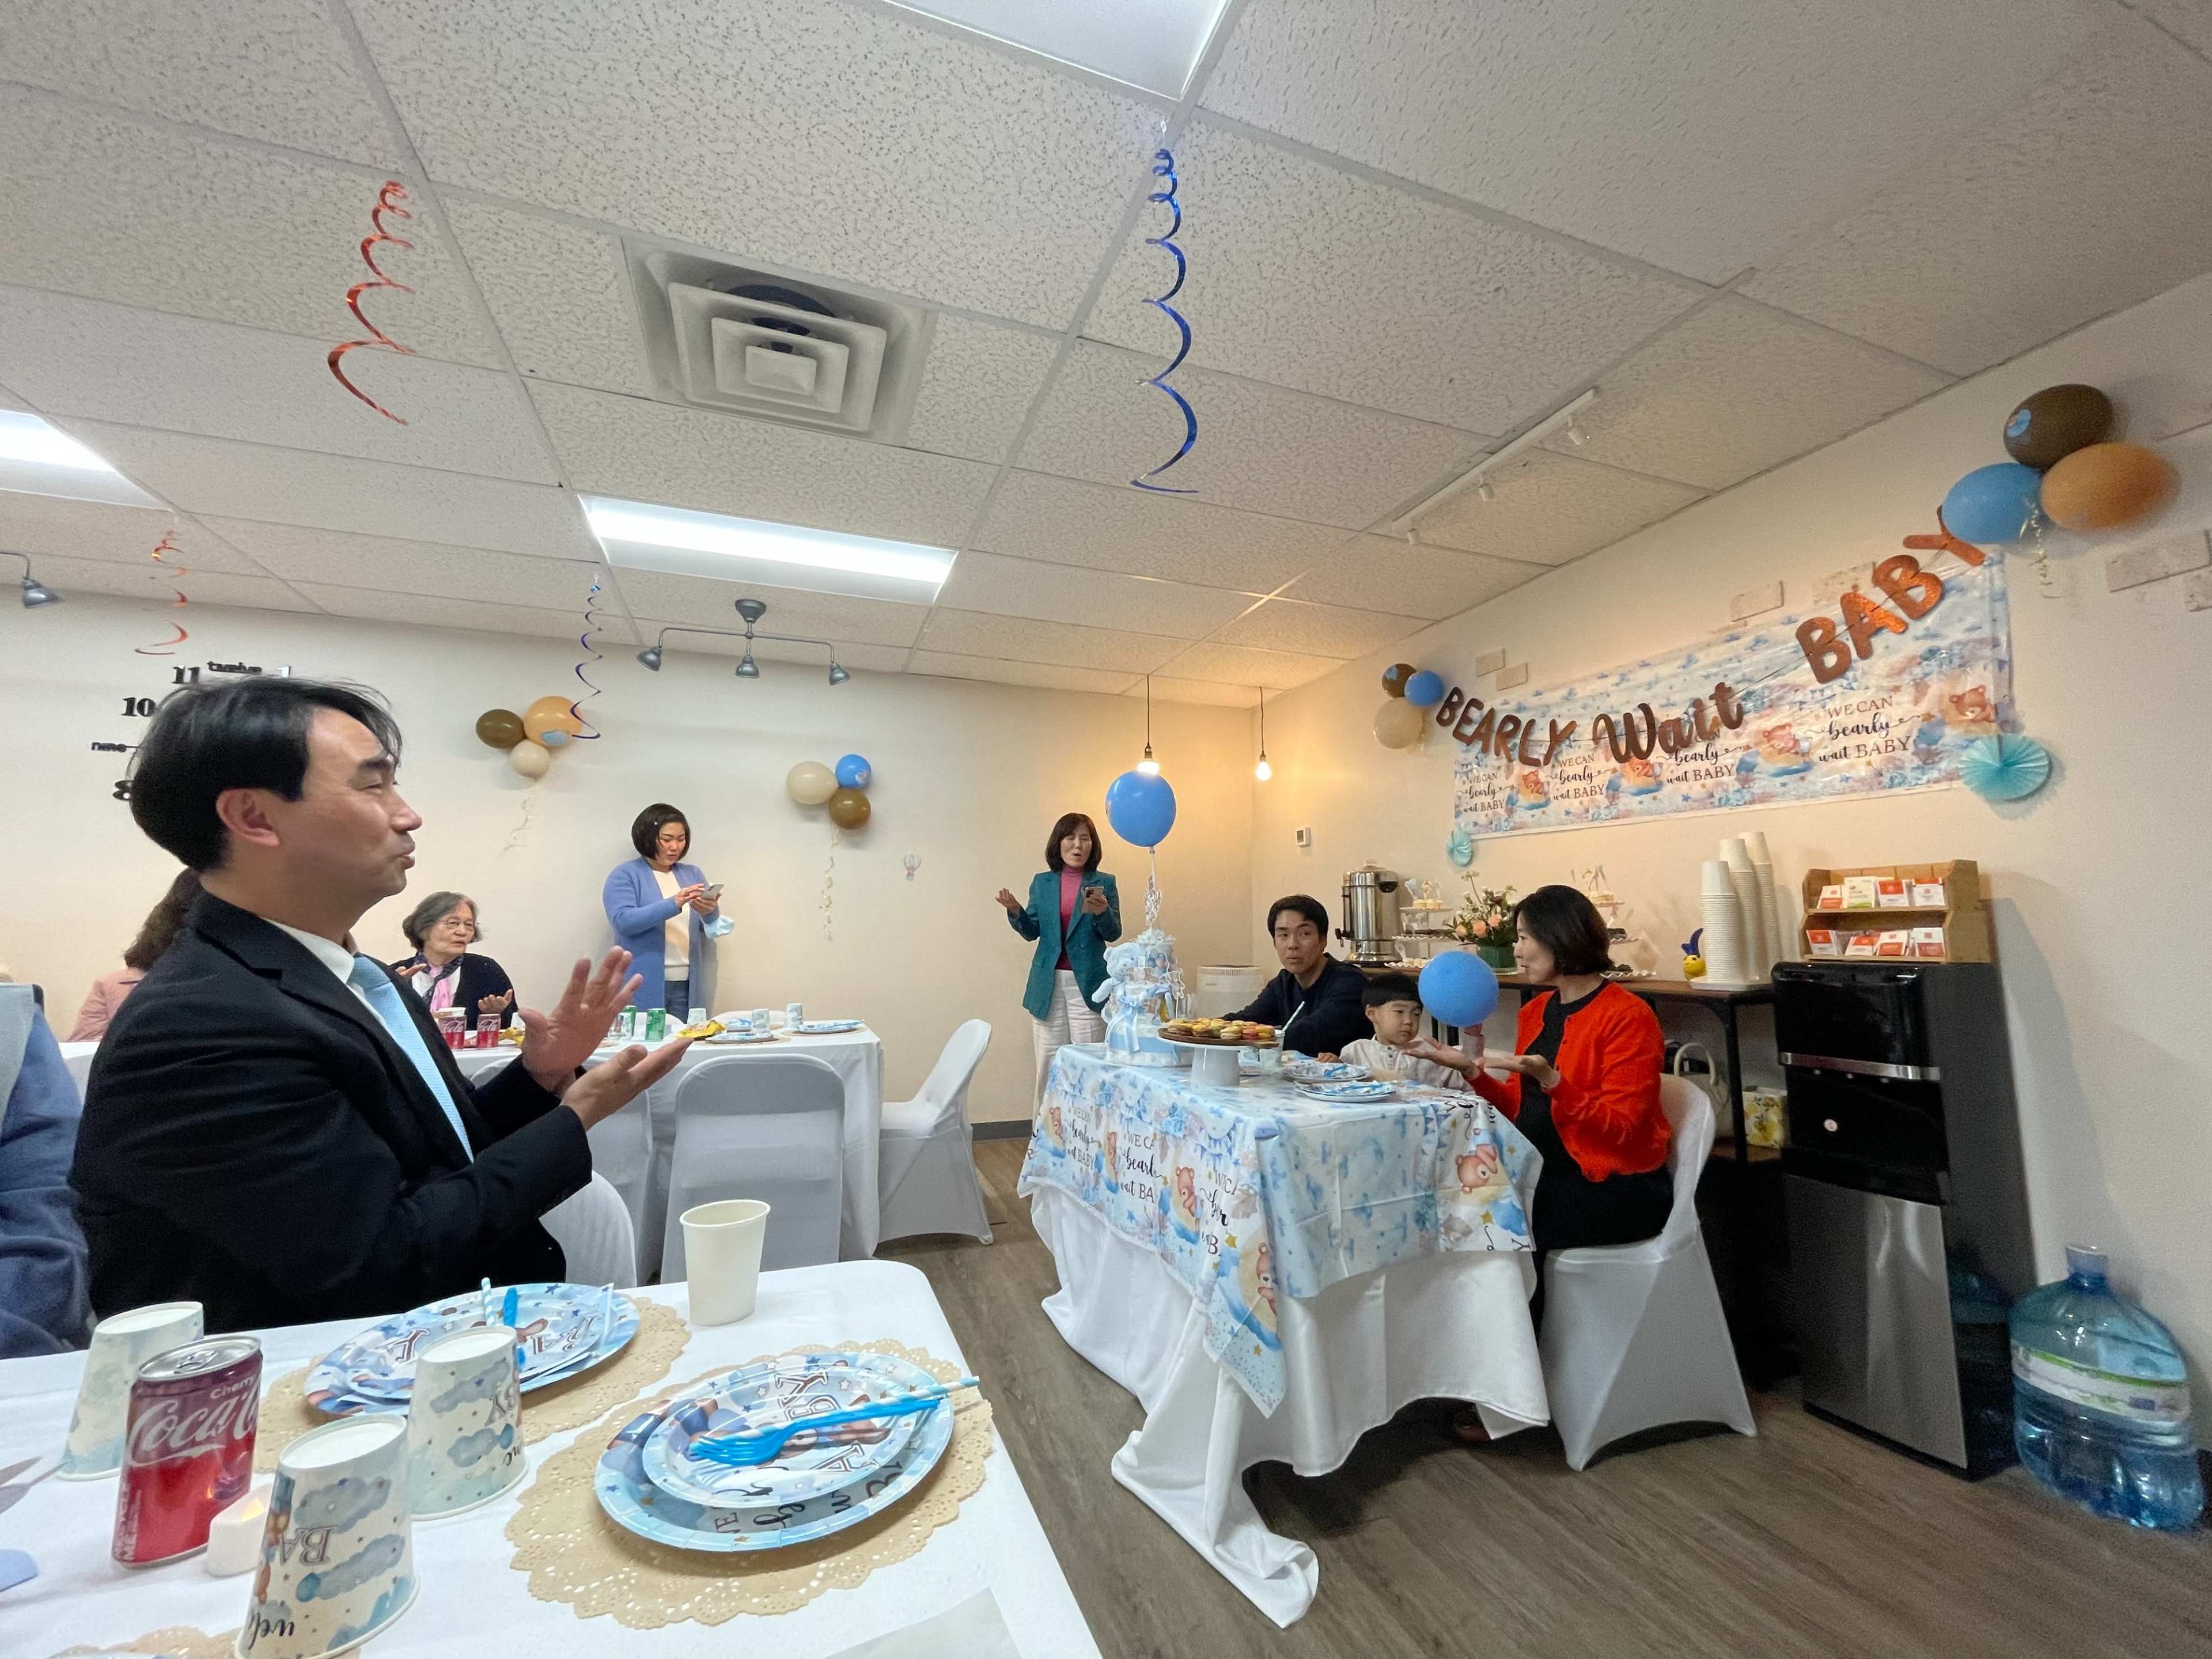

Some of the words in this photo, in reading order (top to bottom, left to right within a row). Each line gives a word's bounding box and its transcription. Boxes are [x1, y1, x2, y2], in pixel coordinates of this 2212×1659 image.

[1436, 687, 1577, 767] BEARLY
[1592, 682, 1744, 763] Wait
[1795, 505, 1986, 684] BABY
[121, 697, 157, 717] 10
[1828, 704, 1854, 718] WE
[1856, 696, 1893, 713] CAN
[1817, 712, 1902, 741] bearly
[1666, 743, 1728, 766] bearly
[1819, 747, 1850, 762] wait
[1855, 736, 1912, 759] BABY
[1557, 759, 1574, 768] WE
[1574, 753, 1596, 766] CAN
[1552, 765, 1601, 785] bearly
[1666, 770, 1689, 784] wait
[1692, 763, 1735, 782] BABY
[1464, 783, 1502, 800] bearly
[1553, 789, 1571, 801] wait
[1573, 784, 1606, 799] BABY
[1480, 799, 1505, 812] BABY
